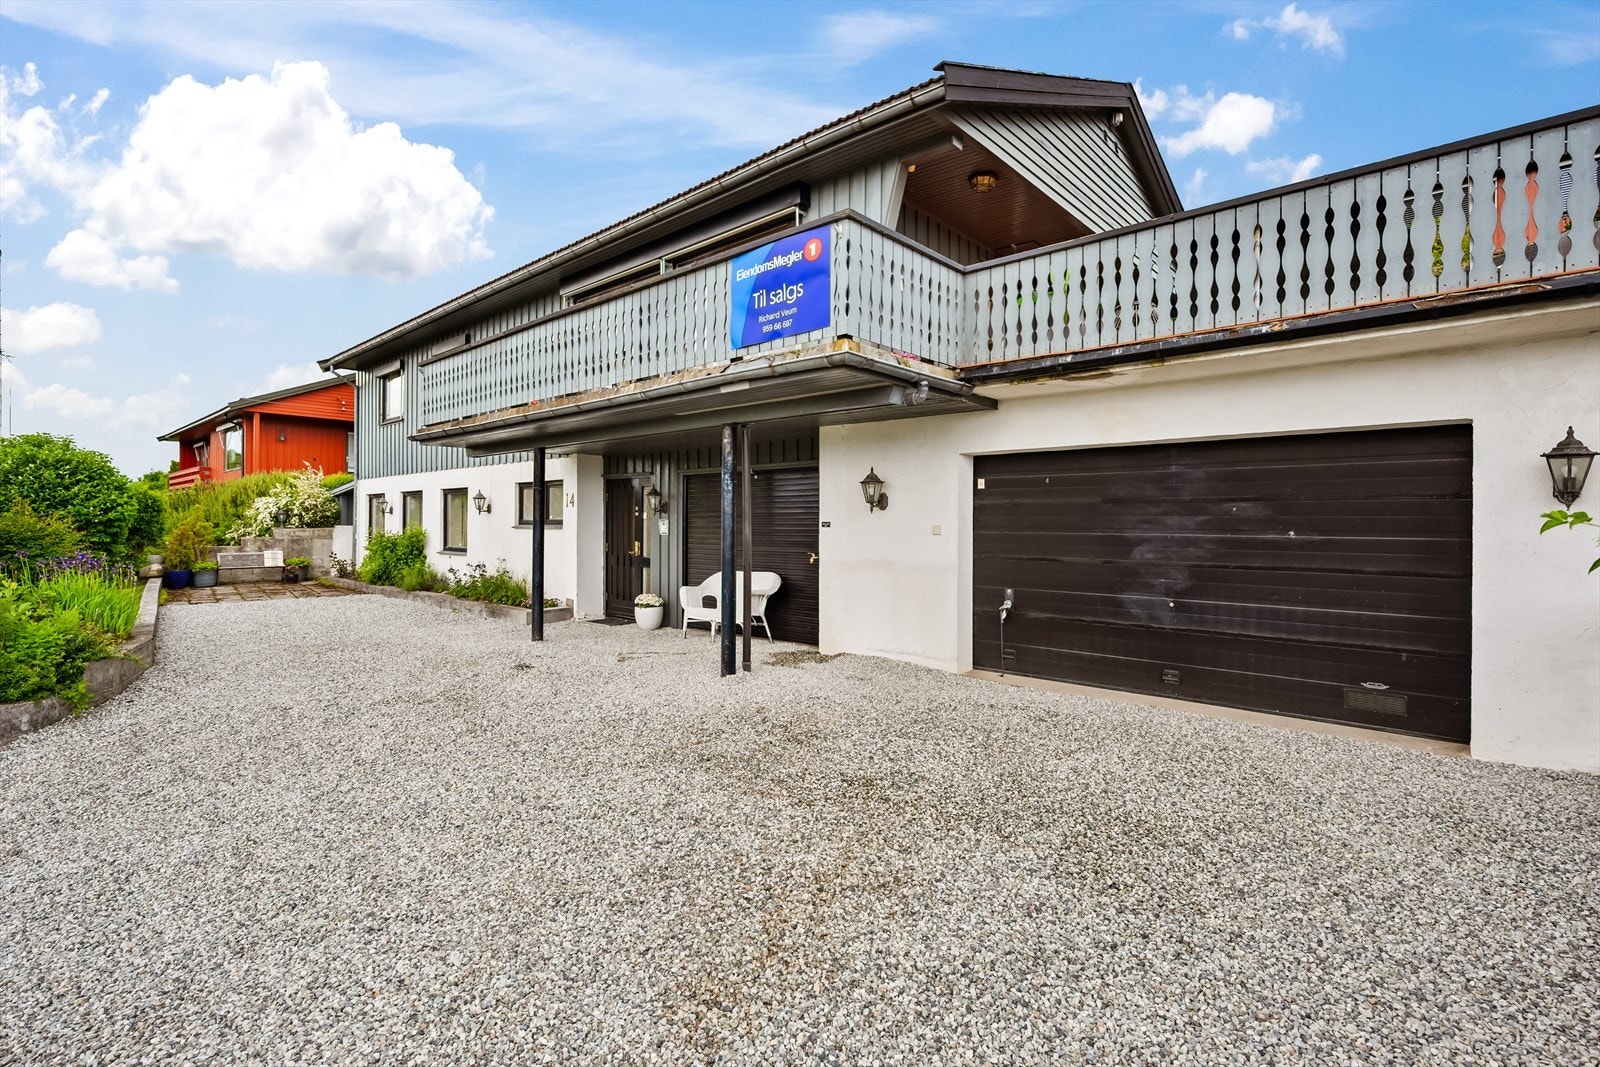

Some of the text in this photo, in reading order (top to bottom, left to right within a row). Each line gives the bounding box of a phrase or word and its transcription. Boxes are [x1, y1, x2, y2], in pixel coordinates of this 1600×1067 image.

[736, 242, 816, 281] EiendomsMegler 1
[752, 283, 804, 309] Til salgs
[758, 307, 797, 323] Richard Veum
[773, 322, 782, 330] 66
[782, 318, 793, 328] 687
[565, 493, 575, 508] 14
